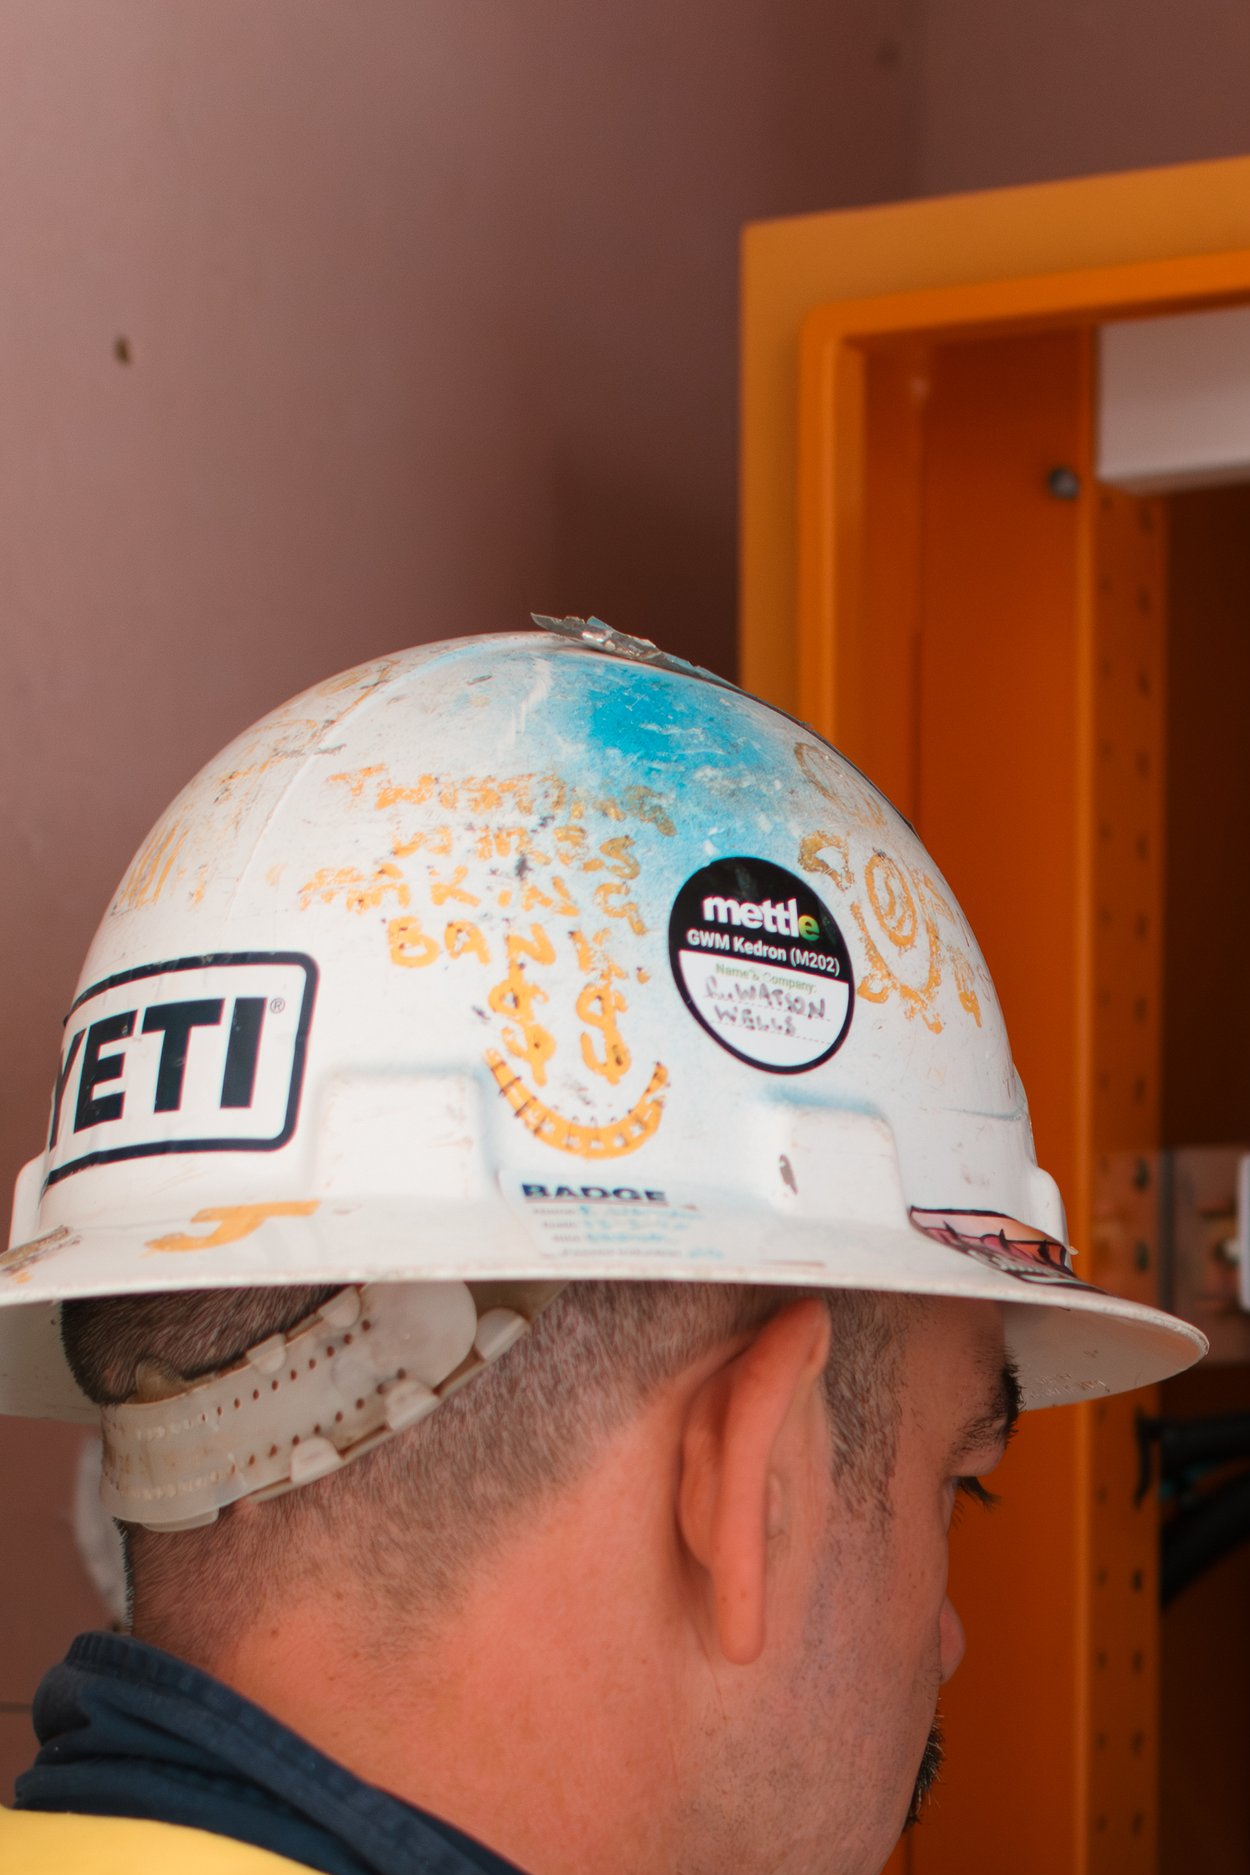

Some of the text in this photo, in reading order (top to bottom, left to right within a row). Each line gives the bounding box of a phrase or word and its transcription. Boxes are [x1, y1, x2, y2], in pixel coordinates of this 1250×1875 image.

[703, 896, 821, 941] mettle
[687, 929, 841, 977] GWM Kedron (M202)
[521, 1183, 669, 1203] BADGE
